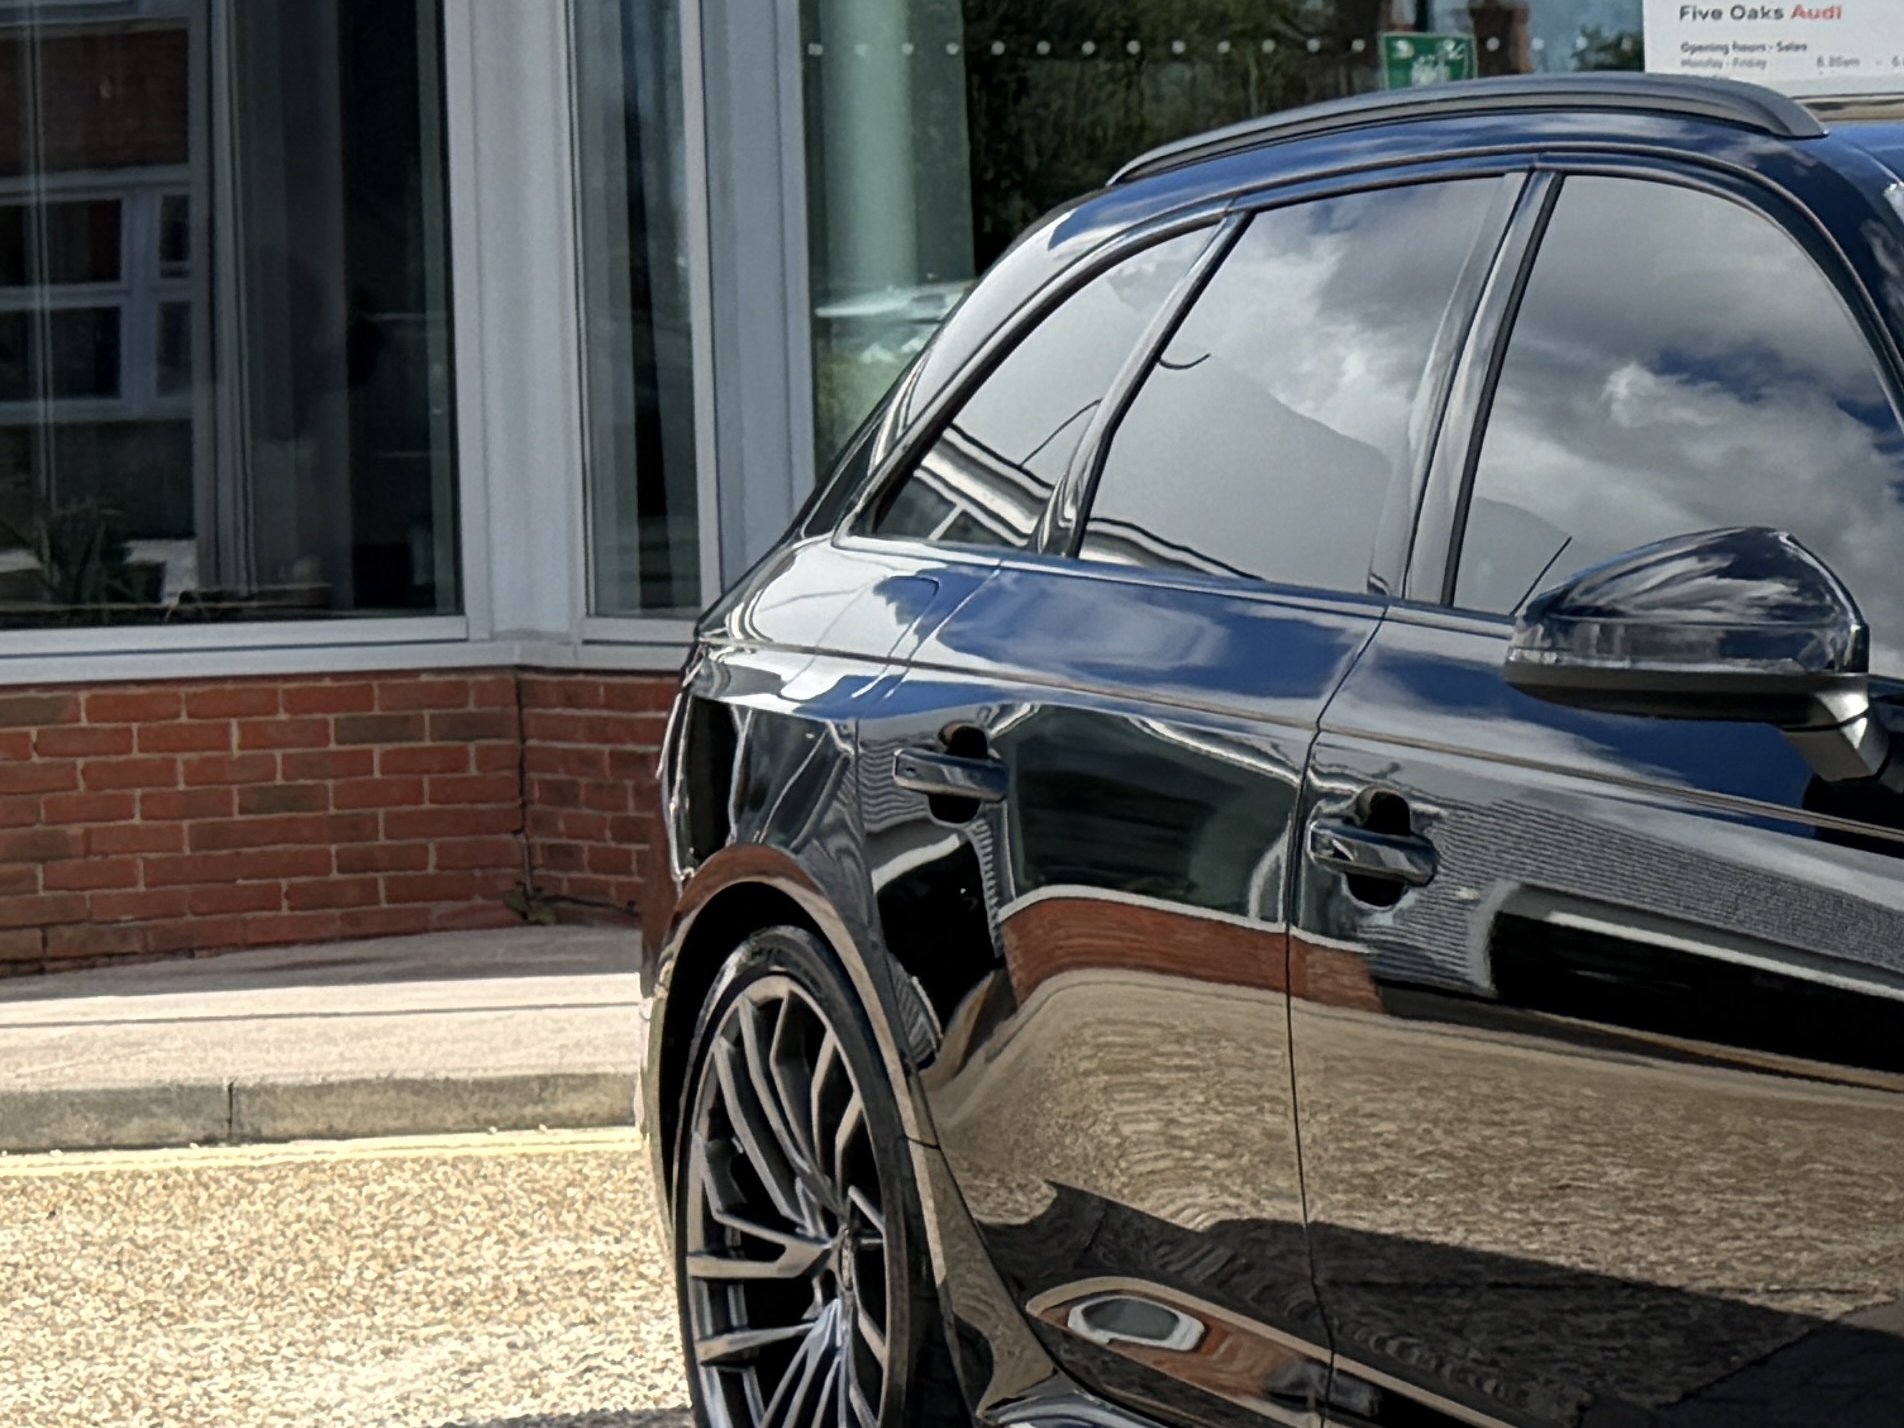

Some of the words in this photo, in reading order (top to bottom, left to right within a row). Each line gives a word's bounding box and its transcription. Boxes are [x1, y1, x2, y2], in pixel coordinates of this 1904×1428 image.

[1679, 5, 1723, 21] Five
[1730, 3, 1785, 21] Oaks
[1790, 3, 1843, 20] Audi
